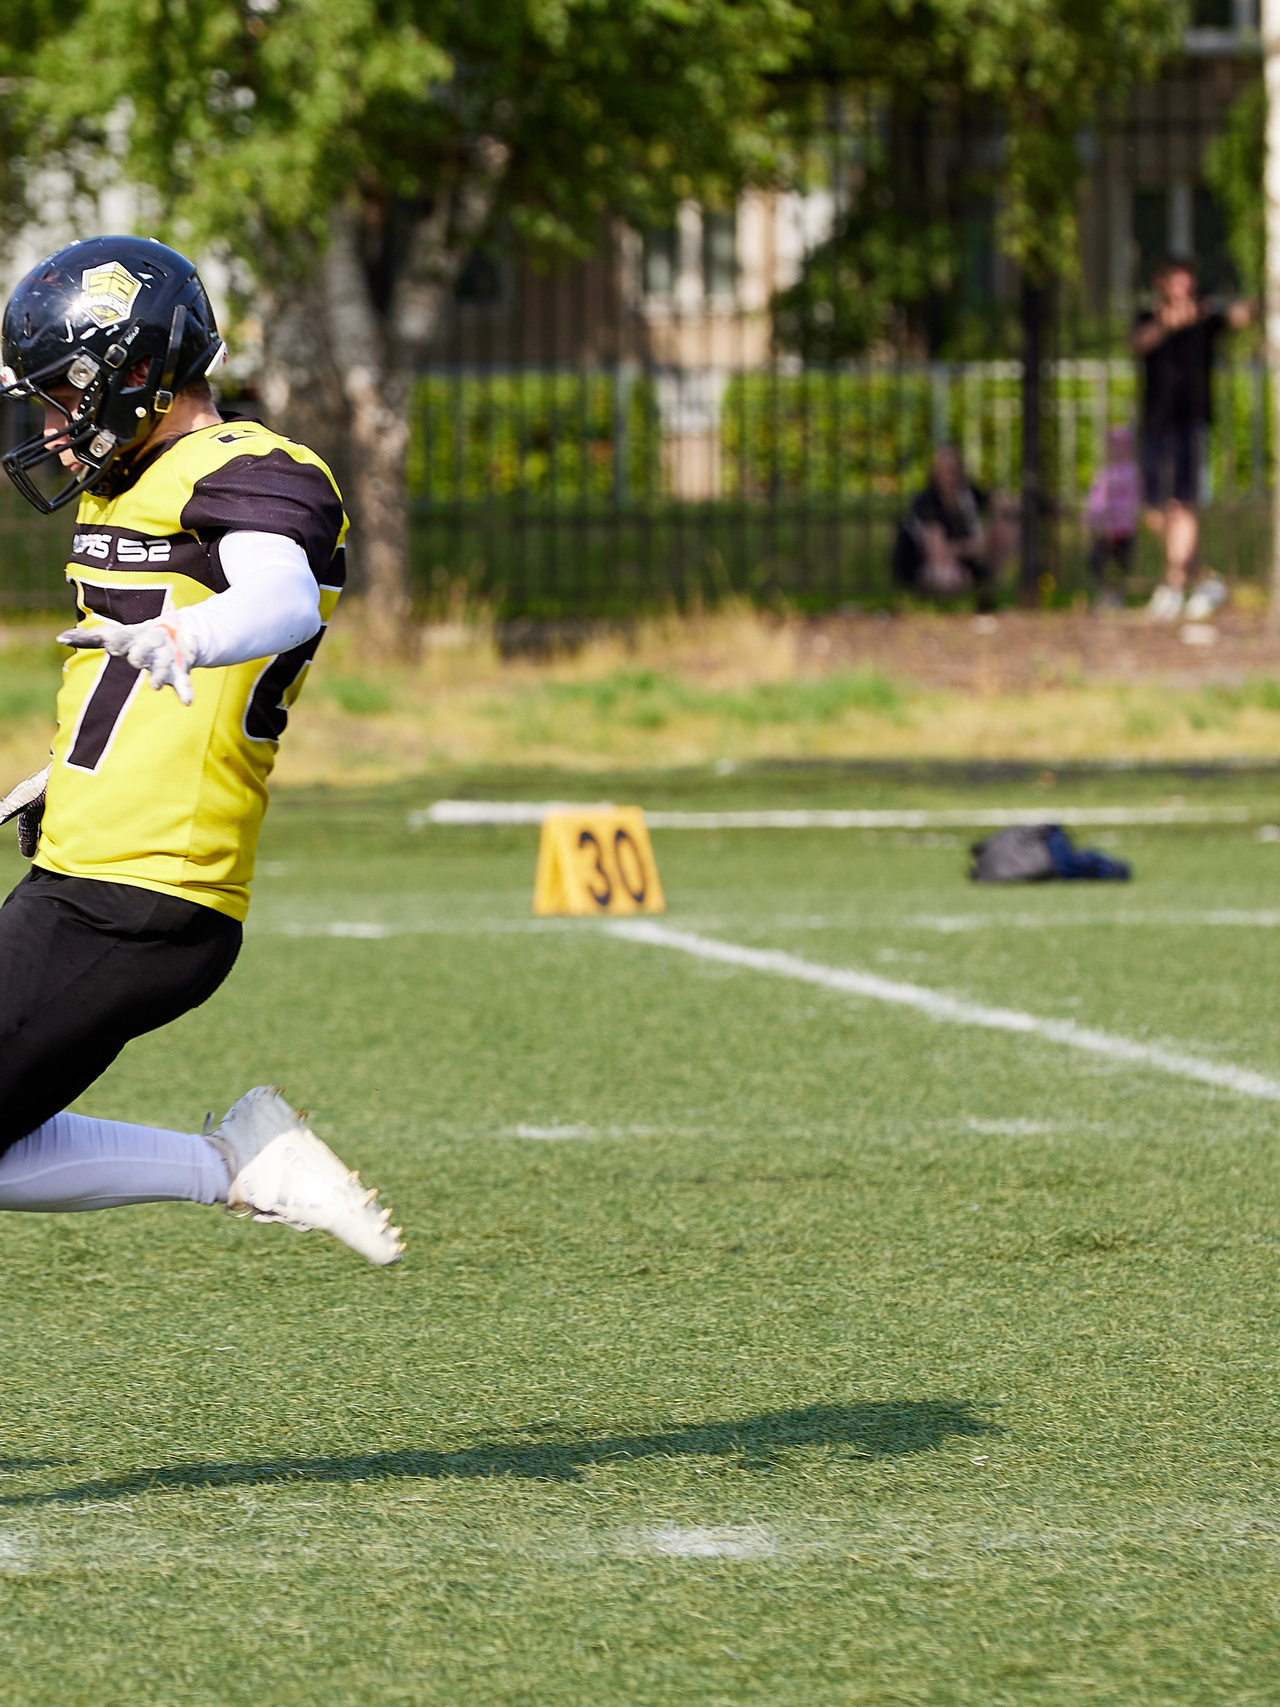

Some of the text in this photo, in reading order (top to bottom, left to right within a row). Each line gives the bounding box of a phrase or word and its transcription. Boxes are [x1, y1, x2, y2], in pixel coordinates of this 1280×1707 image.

[116, 537, 172, 562] 52
[58, 576, 174, 775] 7
[577, 828, 647, 907] 30
